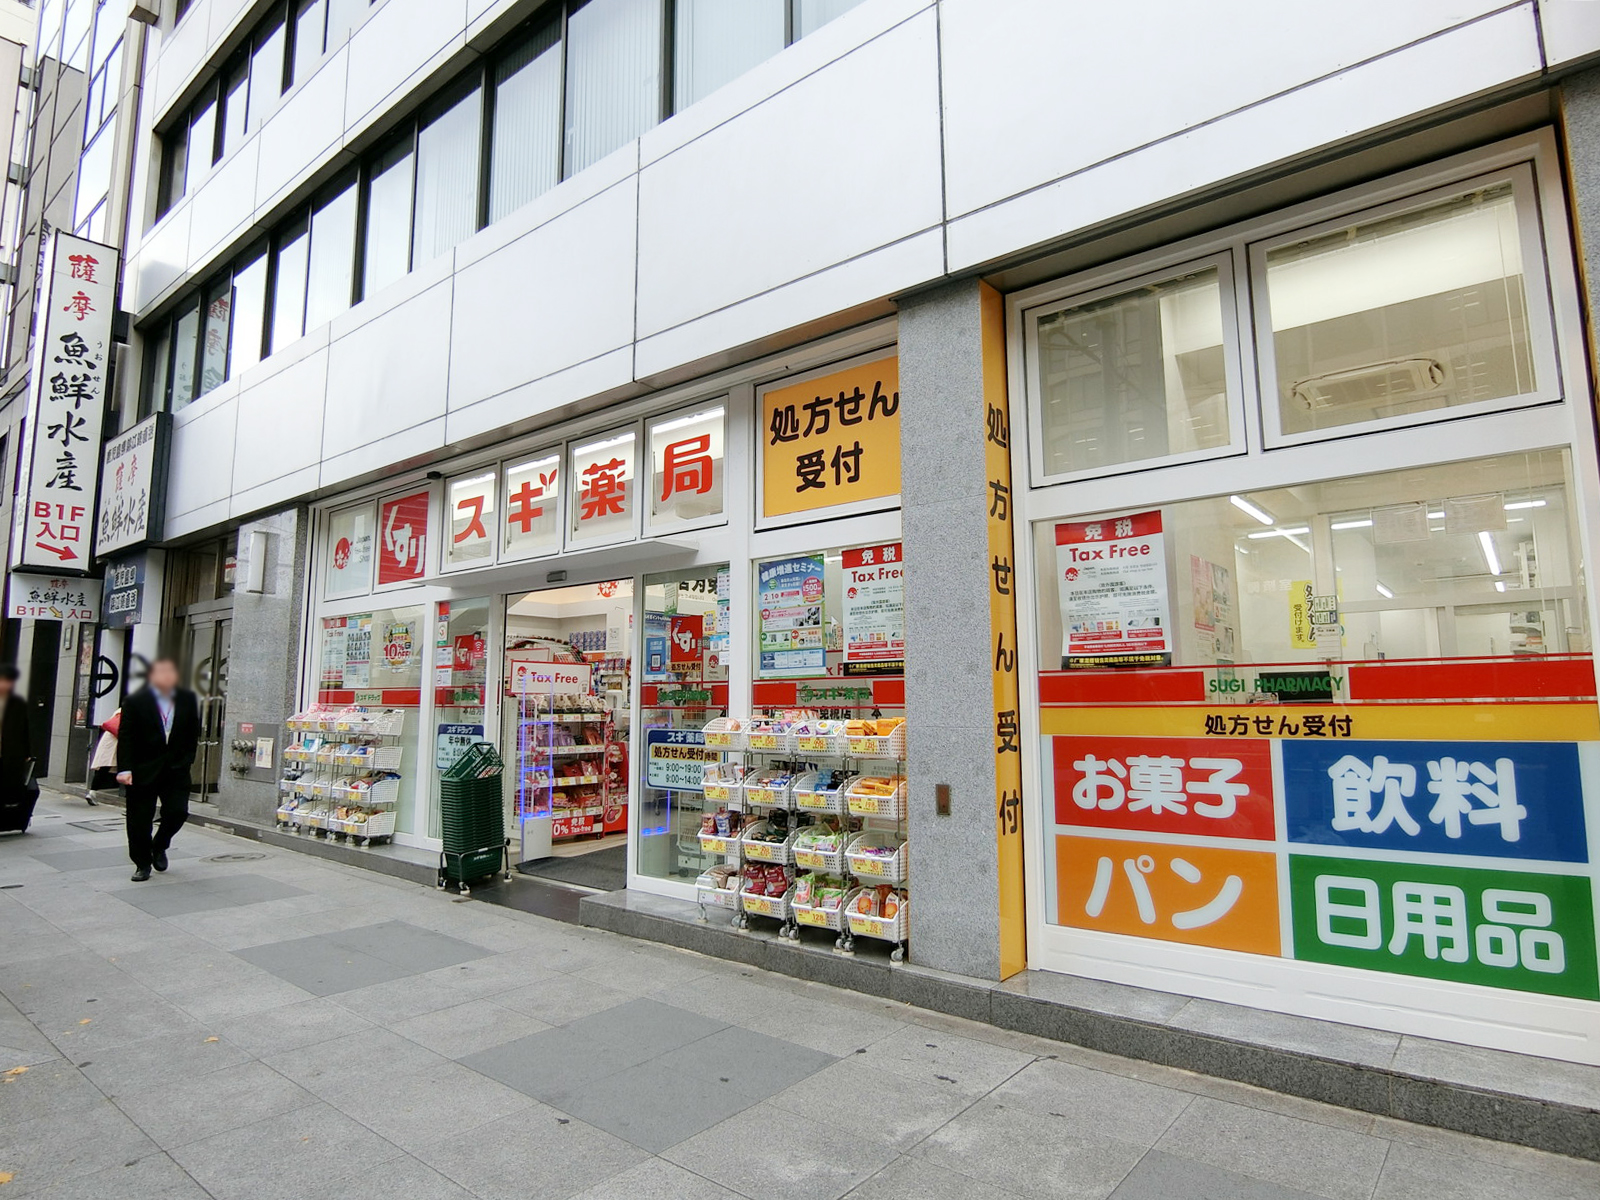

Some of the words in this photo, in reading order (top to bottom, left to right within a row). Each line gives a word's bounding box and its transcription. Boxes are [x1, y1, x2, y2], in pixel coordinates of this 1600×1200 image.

[46, 331, 97, 491] 魚鮮水産
[770, 380, 899, 446] 処方せん
[796, 441, 864, 493] 受付
[454, 433, 713, 544] スギ薬局
[34, 501, 86, 522] B1F
[35, 522, 81, 542] 入口
[385, 504, 426, 575] くすり
[1084, 518, 1134, 541] 免税
[861, 546, 896, 564] 免税
[1069, 547, 1104, 562] Tax
[1109, 544, 1150, 559] Free
[851, 570, 875, 583] Tax
[27, 590, 87, 607] 魚鮮水産
[16, 606, 48, 616] B1F
[67, 609, 92, 619] 入口
[986, 402, 1020, 835] 処方せん受付
[672, 619, 702, 658] くすり
[531, 671, 552, 683] Tax
[554, 672, 579, 684] Free
[1209, 678, 1245, 694] SUGI
[1254, 676, 1344, 695] PHARMACY
[1205, 714, 1353, 737] 処方せん受付
[666, 731, 705, 744] スギ薬局
[1072, 753, 1250, 819] お菓子
[1327, 754, 1528, 842] 飲料
[1084, 854, 1243, 929] パン
[1314, 874, 1566, 974] 日用品
